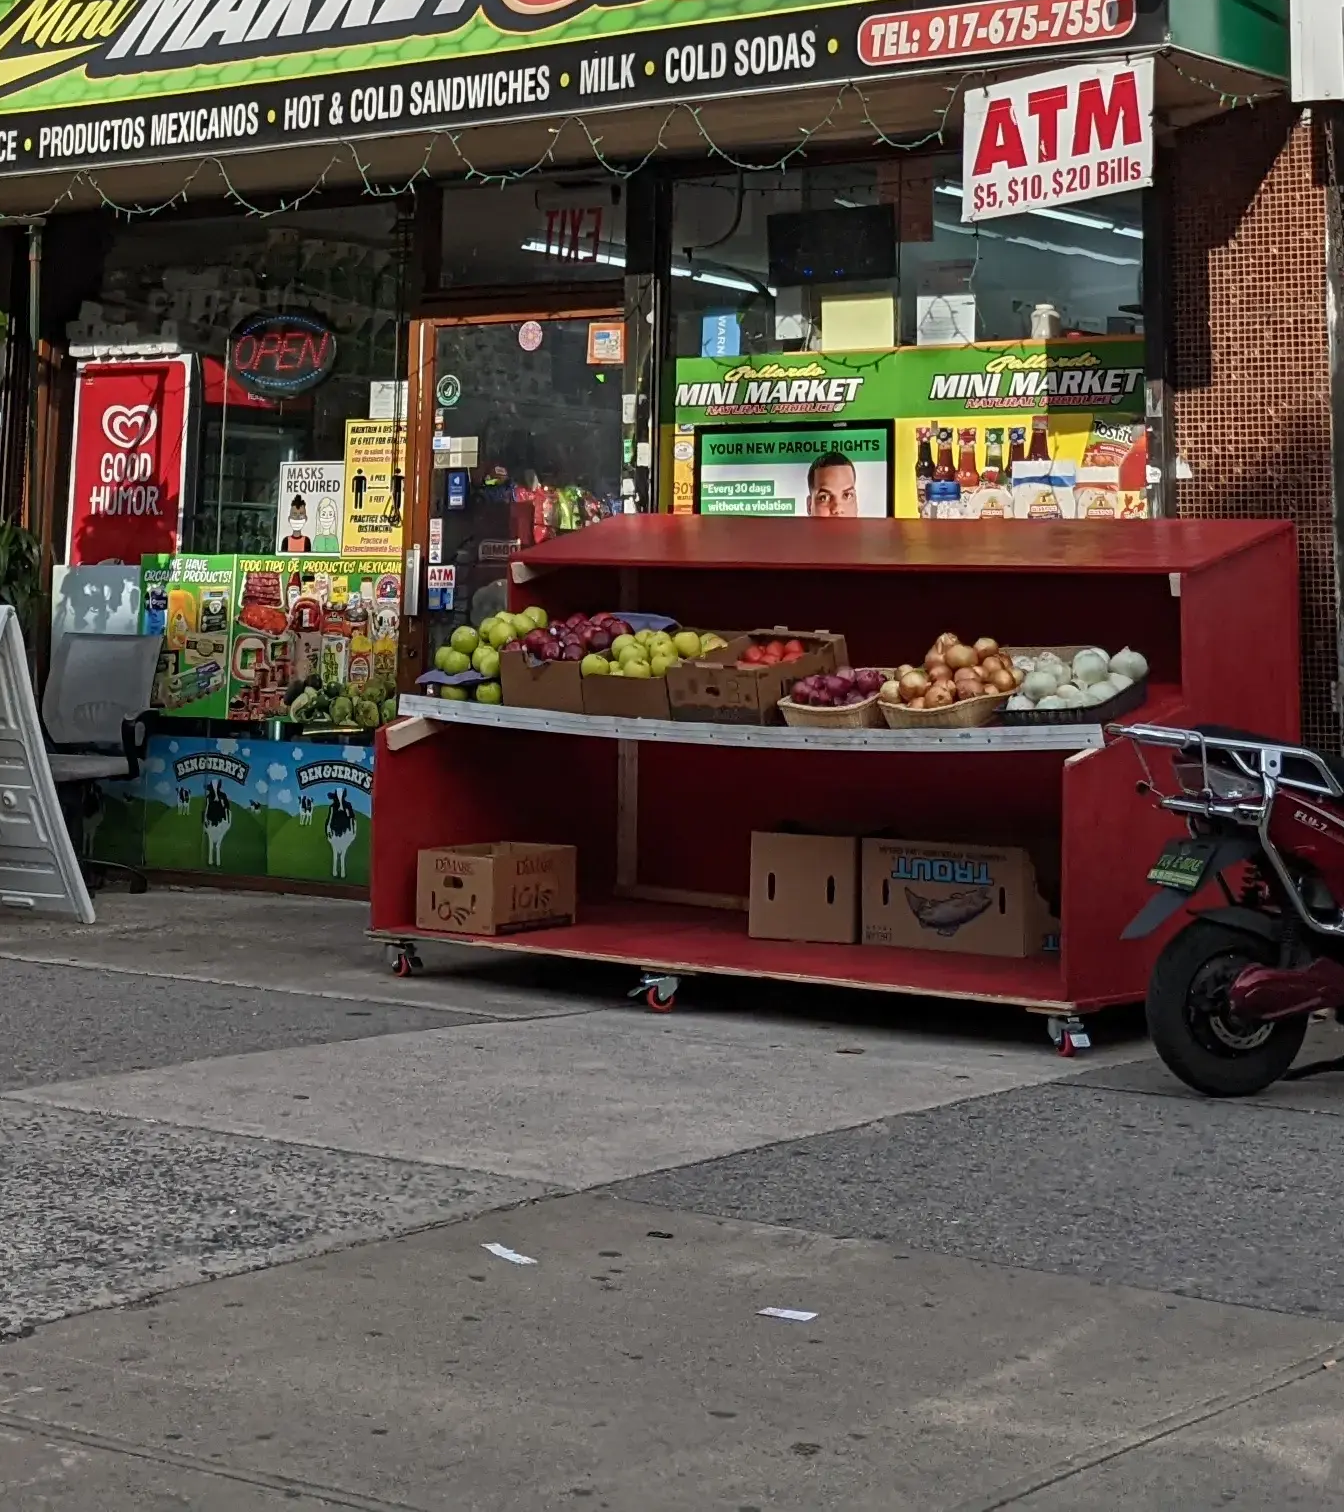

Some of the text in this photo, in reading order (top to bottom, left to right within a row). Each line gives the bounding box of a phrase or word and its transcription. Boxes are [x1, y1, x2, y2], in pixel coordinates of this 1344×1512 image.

[870, 20, 921, 58] TEL:
[38, 116, 145, 160] PRODUCTOS
[150, 101, 259, 148] MEXICANOS
[283, 94, 325, 131] HOT
[329, 93, 344, 127] &
[349, 82, 404, 123] COLD
[408, 65, 550, 117] SANDWICHES
[579, 52, 635, 97] MILK
[664, 42, 728, 86] COLD
[734, 30, 817, 78] SODAS
[972, 71, 1142, 177] ATM
[973, 158, 1142, 210] $5, $10, $20 Bills
[234, 332, 329, 372] OPEN
[724, 362, 825, 382] Gallardo
[986, 352, 1101, 373] Gallardo
[675, 377, 863, 406] MINI MARKET
[929, 368, 1144, 399] MINI MARKET
[709, 439, 880, 455] YOUR NEW PAROLE RIGHTS
[100, 452, 152, 483] GOOD
[287, 467, 324, 481] MASKS
[286, 480, 340, 494] REQUIRED
[735, 483, 747, 493] 30
[749, 483, 771, 495] days
[708, 501, 745, 512] without
[752, 501, 792, 511] violation
[185, 558, 208, 571] HAVE
[239, 559, 261, 572] TODO
[265, 560, 284, 573] TIPO
[287, 560, 299, 573] DE
[303, 560, 355, 574] PRODUCTOS
[144, 570, 232, 583] ORGANIC PRODUCTS!
[429, 569, 454, 581] ATM
[892, 856, 995, 887] TROUT
